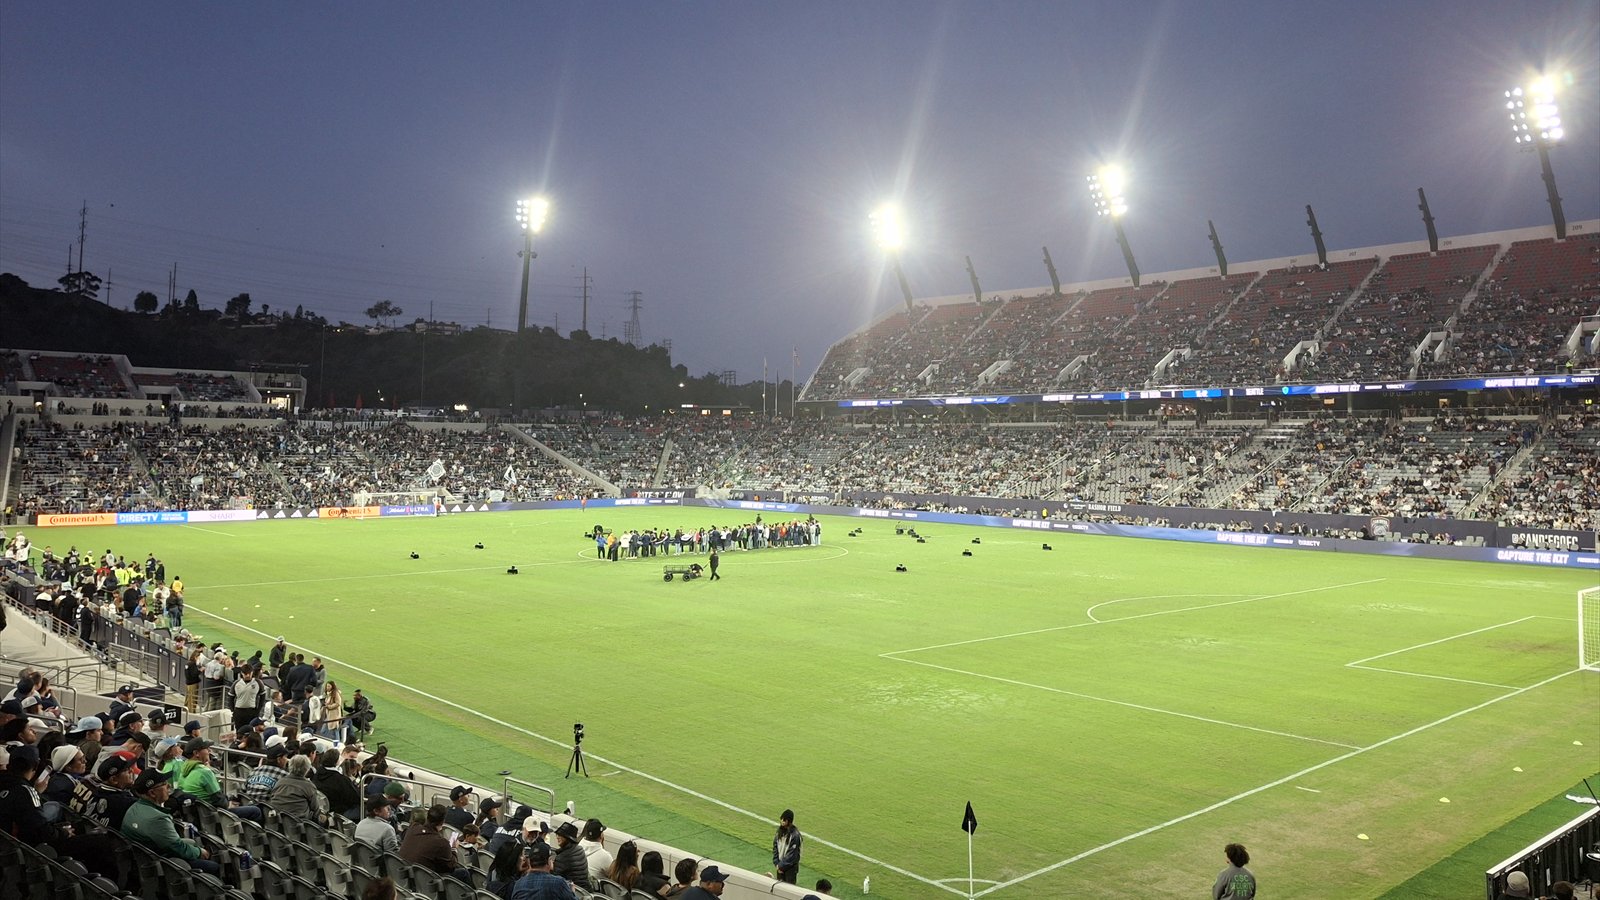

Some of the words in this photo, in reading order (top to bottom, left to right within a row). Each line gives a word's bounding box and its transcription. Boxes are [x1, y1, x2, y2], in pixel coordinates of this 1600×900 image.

[49, 515, 98, 525] Continental
[119, 512, 159, 523] DIRECTV
[1498, 550, 1534, 561] CAPTURE
[1535, 552, 1552, 563] THE
[1552, 553, 1569, 564] KIT
